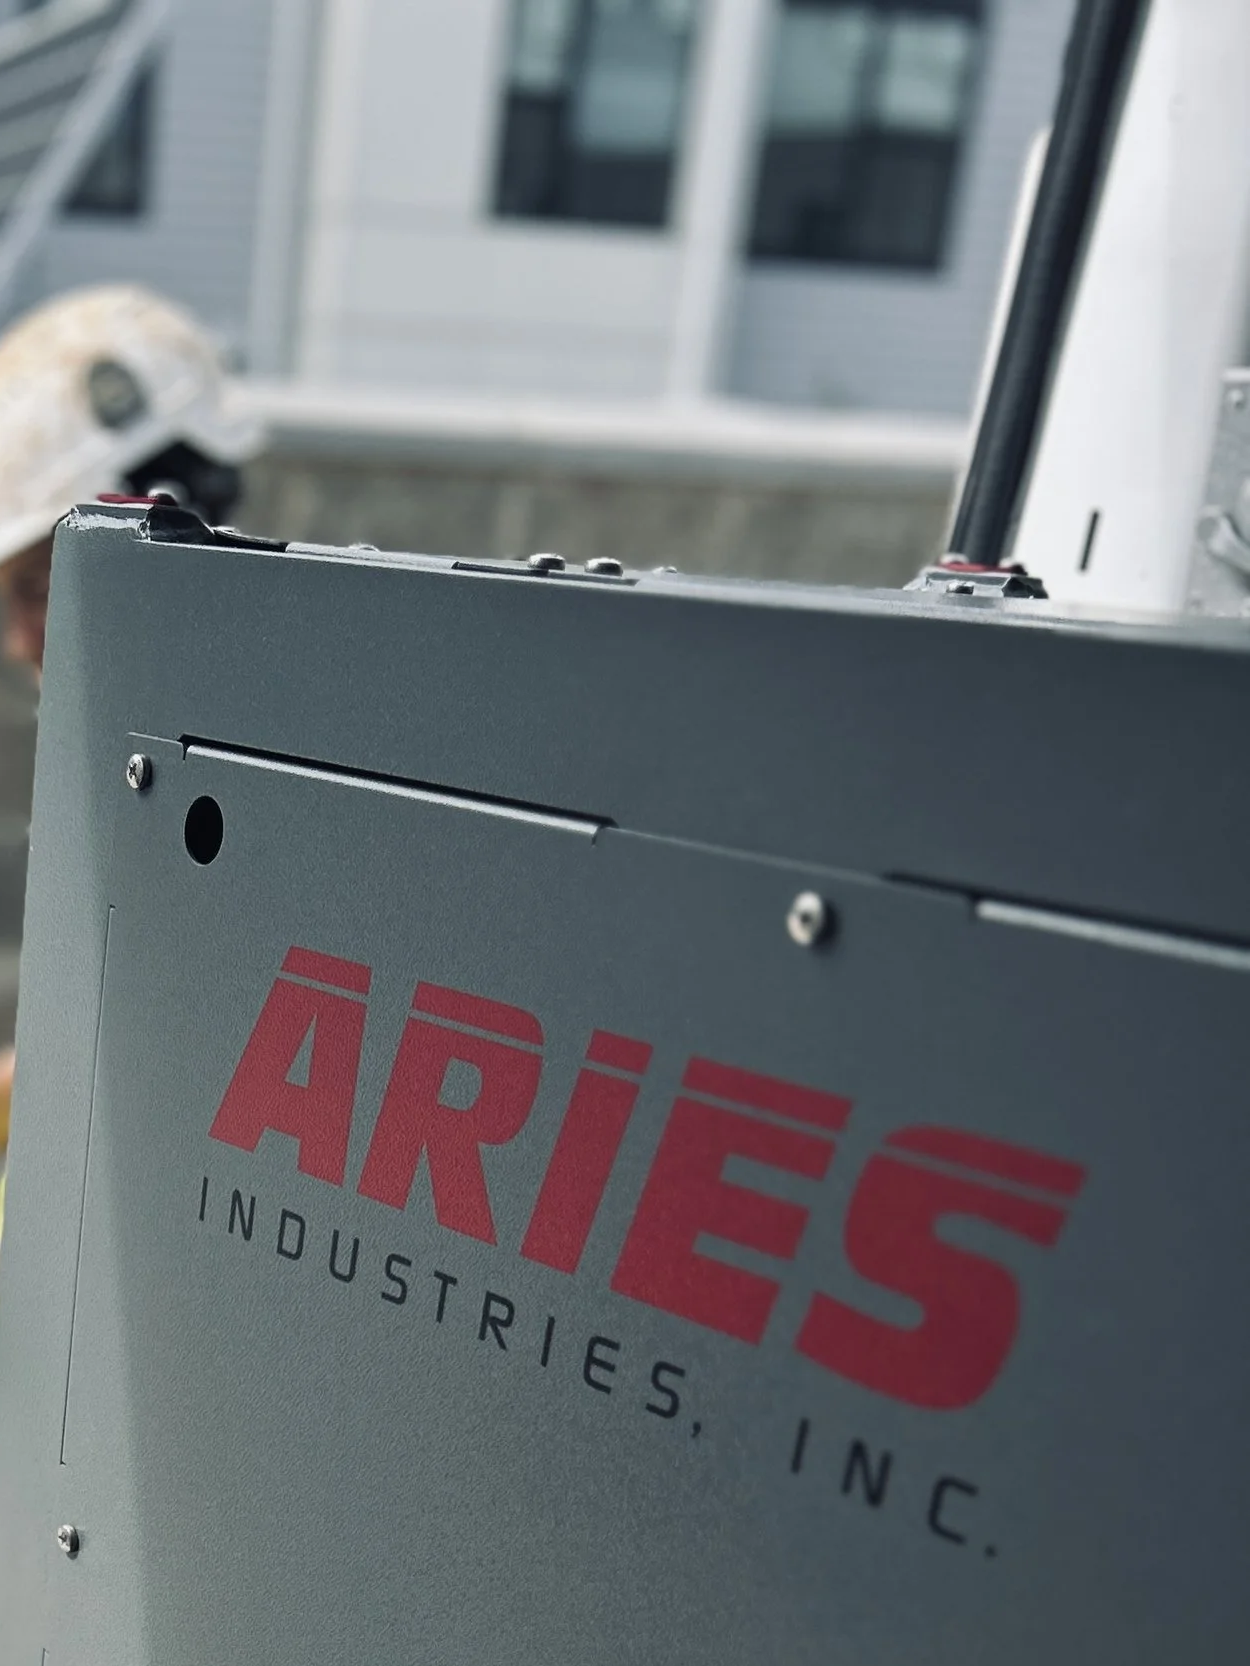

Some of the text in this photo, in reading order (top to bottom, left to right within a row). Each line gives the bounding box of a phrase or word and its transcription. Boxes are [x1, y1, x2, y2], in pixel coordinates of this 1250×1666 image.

[197, 1175, 998, 1557] INDUSTRIES, INC.
[208, 945, 1088, 1412] ARIES
